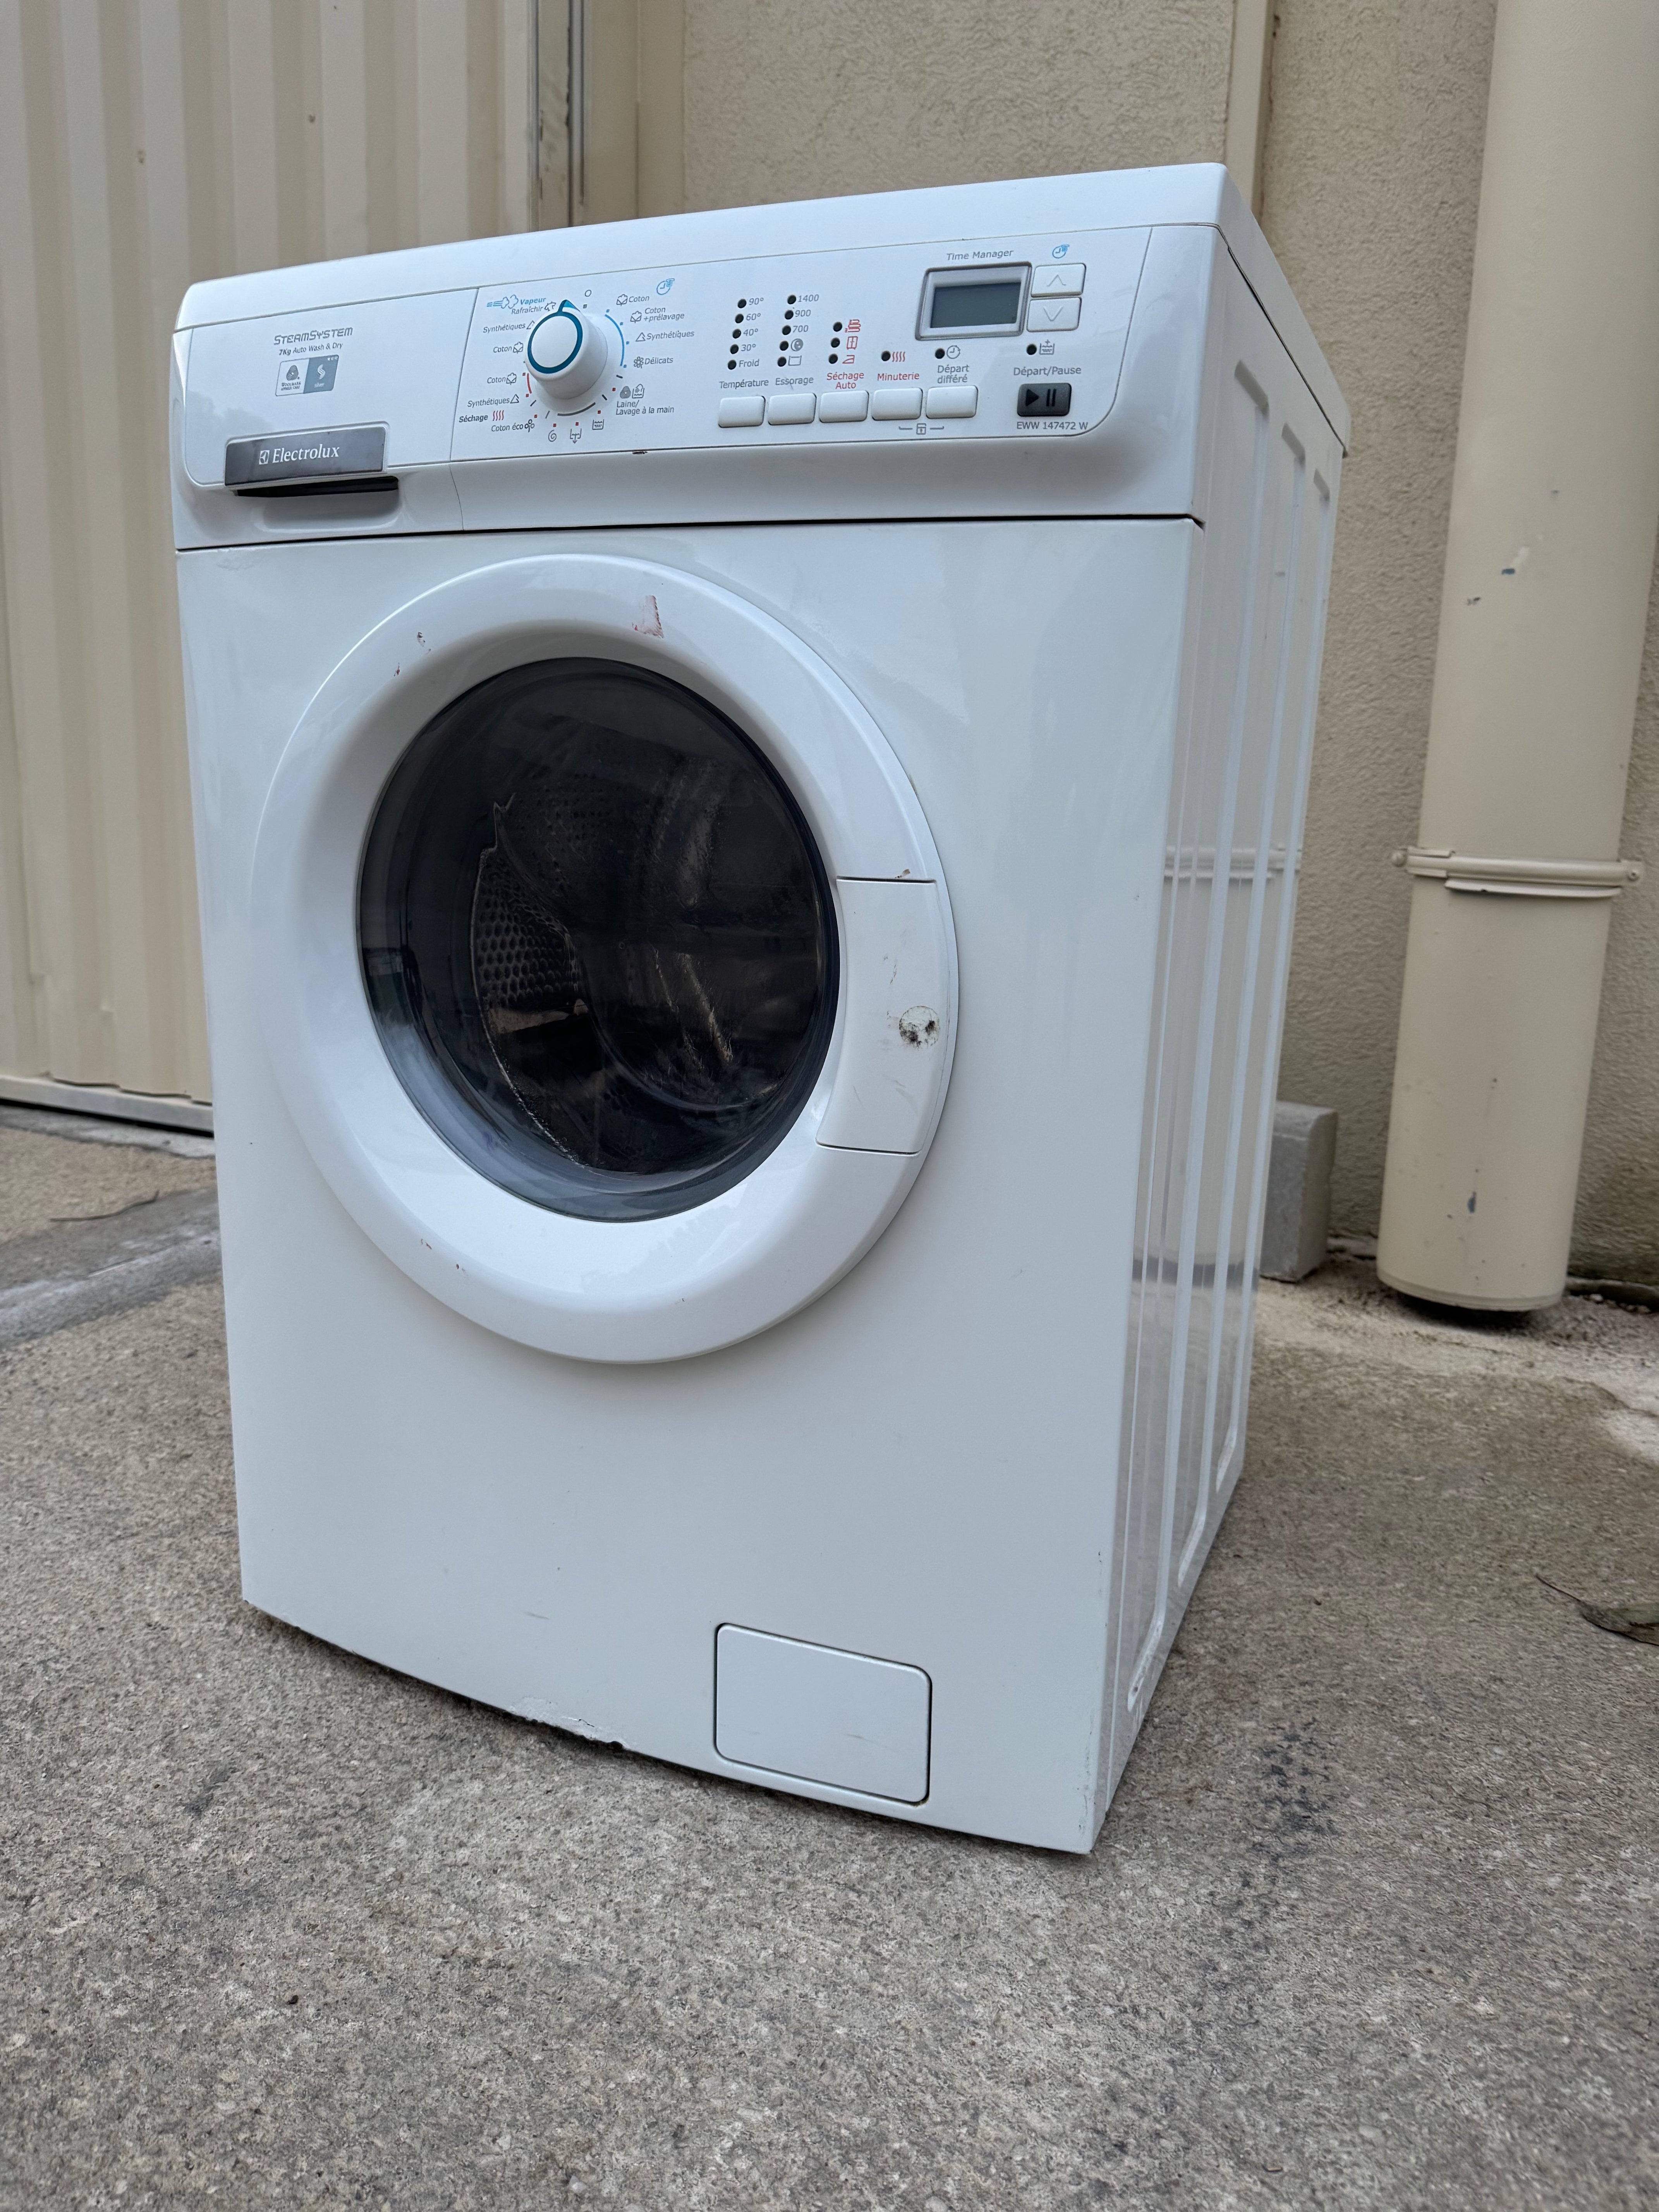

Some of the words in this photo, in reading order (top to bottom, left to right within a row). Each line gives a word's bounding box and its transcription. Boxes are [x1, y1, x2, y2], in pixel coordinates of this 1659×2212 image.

[947, 252, 969, 261] Time
[972, 249, 1013, 260] Manager
[749, 297, 764, 305] 90°
[798, 294, 819, 302] 1400
[644, 314, 684, 322] +prélavage
[746, 313, 761, 321] 60°
[795, 309, 811, 318] 900
[483, 323, 526, 333] Synthétiques
[743, 328, 758, 337] 40°
[792, 325, 808, 333] 700
[647, 331, 694, 341] Synthétiques
[741, 343, 756, 352] 30°
[739, 359, 759, 368] Froid
[938, 364, 969, 374] Départ
[1013, 366, 1081, 377] Départ/Pause
[827, 371, 864, 381] Séchage
[877, 372, 919, 381] Minuterie
[937, 374, 968, 384] différé
[719, 378, 769, 389] Température
[775, 376, 814, 386] Essorage
[467, 398, 510, 408] Synthétiques
[1043, 422, 1076, 430] 147472
[272, 444, 339, 463] Electrolux
